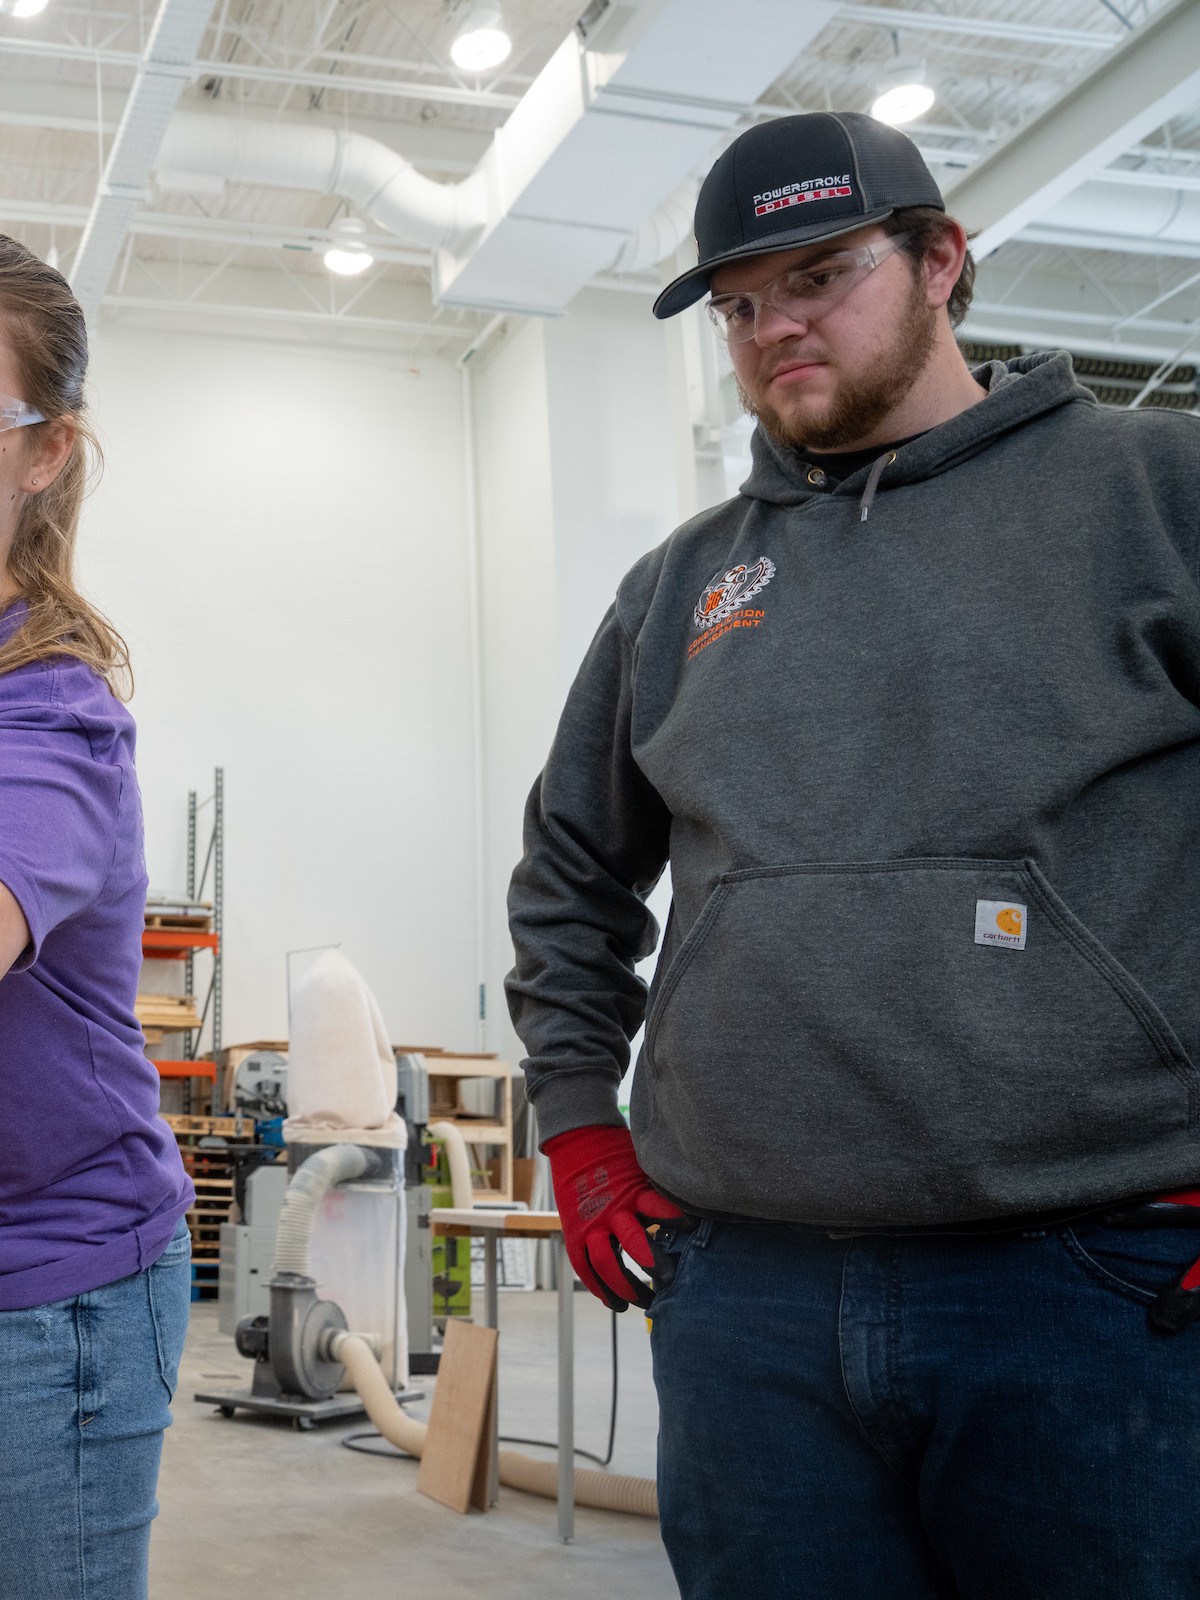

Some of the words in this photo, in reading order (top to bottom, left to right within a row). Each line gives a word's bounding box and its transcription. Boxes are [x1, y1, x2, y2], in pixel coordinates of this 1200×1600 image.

[753, 174, 850, 205] POWERSTROKE
[764, 187, 843, 211] DIESEL
[983, 932, 1021, 943] carhartt
